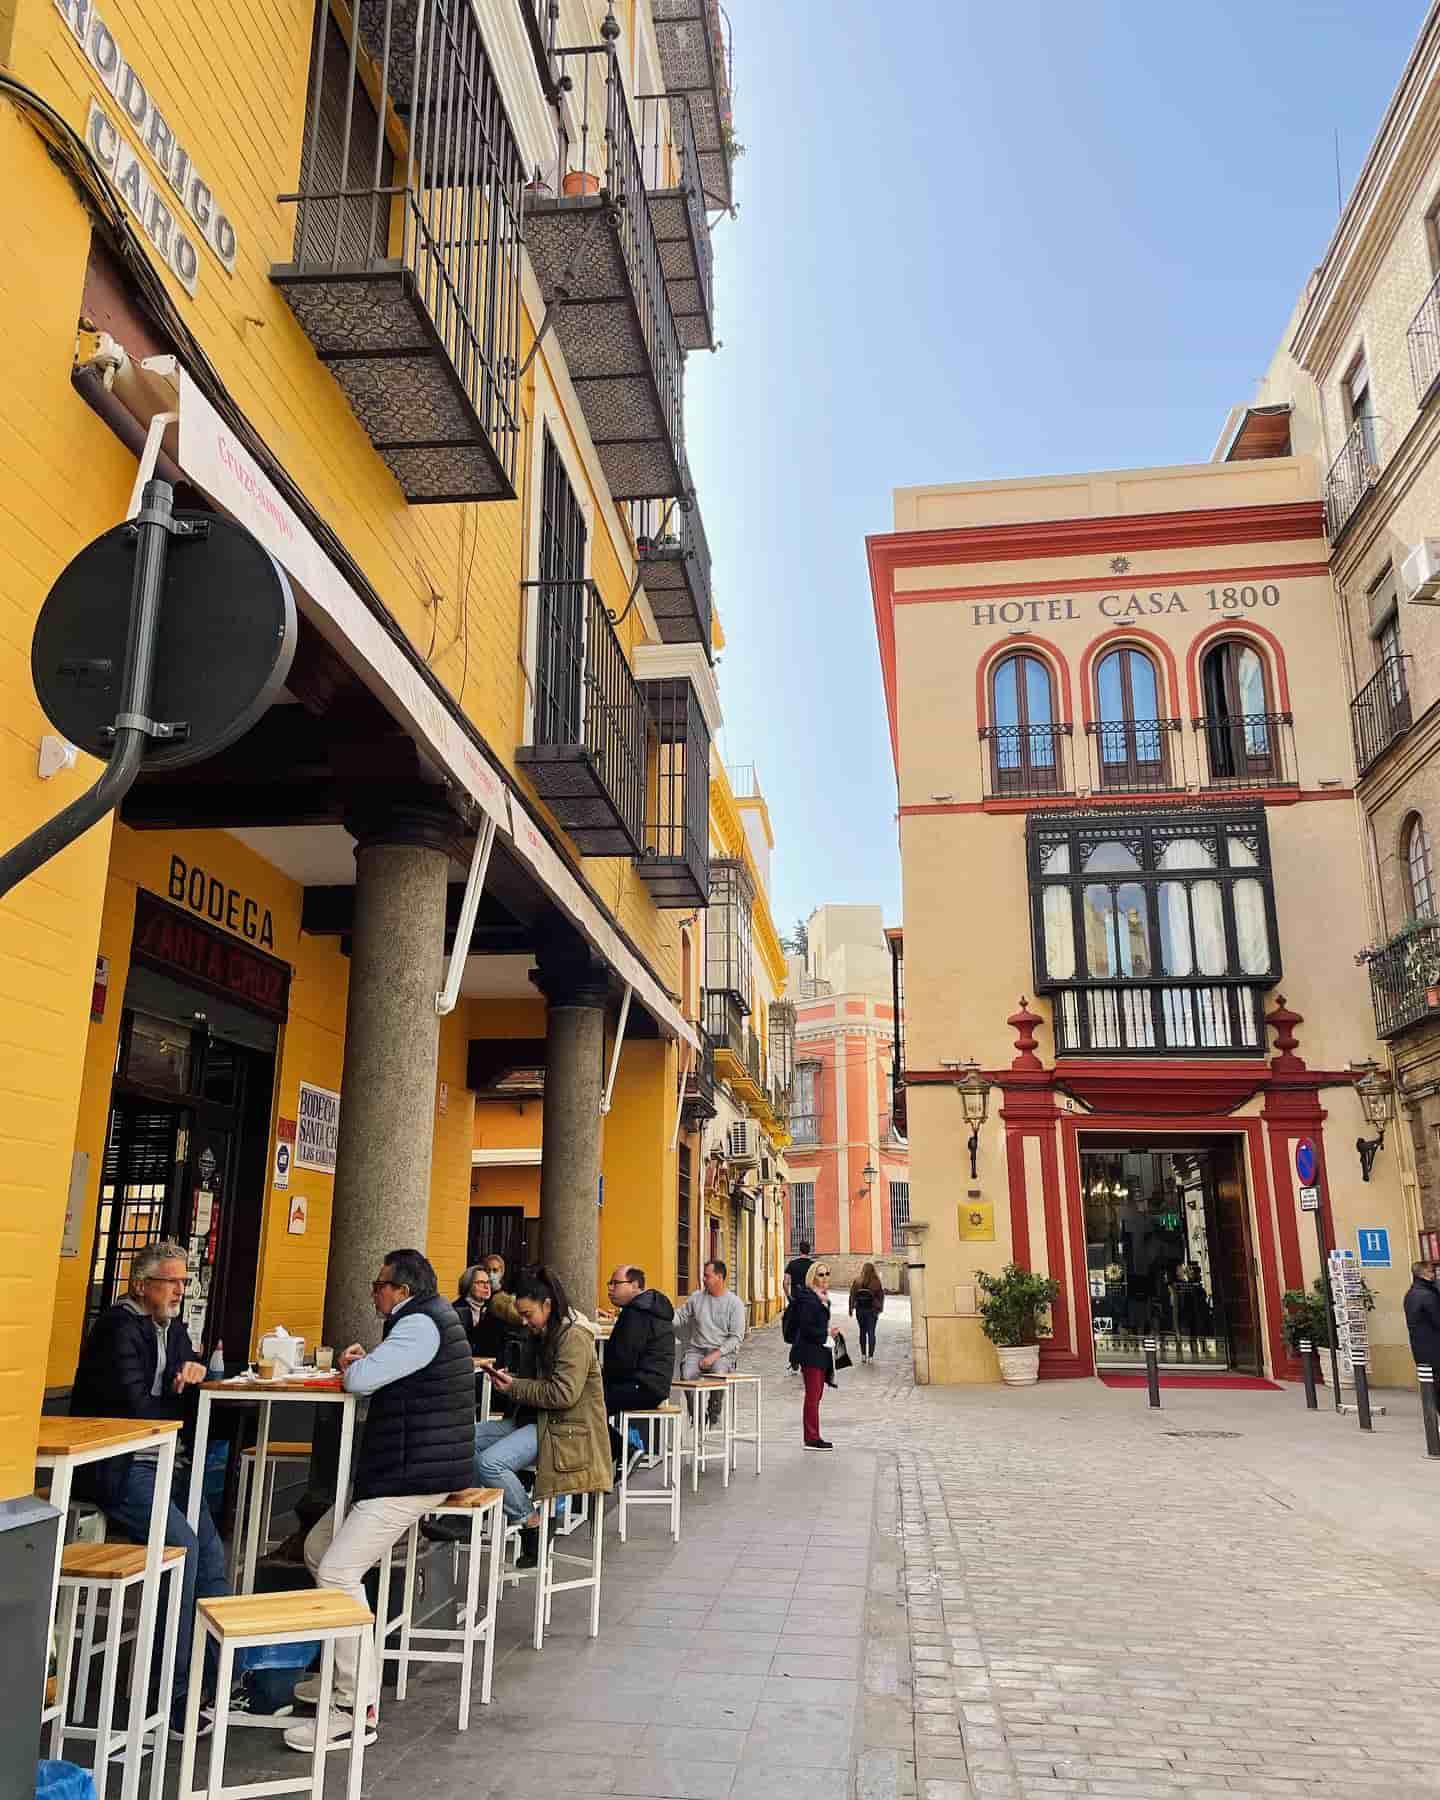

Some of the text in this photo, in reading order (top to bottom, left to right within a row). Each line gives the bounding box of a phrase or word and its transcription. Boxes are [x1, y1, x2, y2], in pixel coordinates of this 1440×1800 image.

[90, 110, 198, 284] CARO
[972, 584, 1282, 626] HOTEL CASA 1800
[169, 855, 273, 948] BODEGA
[300, 1088, 336, 1124] BODEGA
[300, 1119, 326, 1147] SANTA
[326, 1127, 338, 1149] CR
[1365, 1232, 1383, 1251] H
